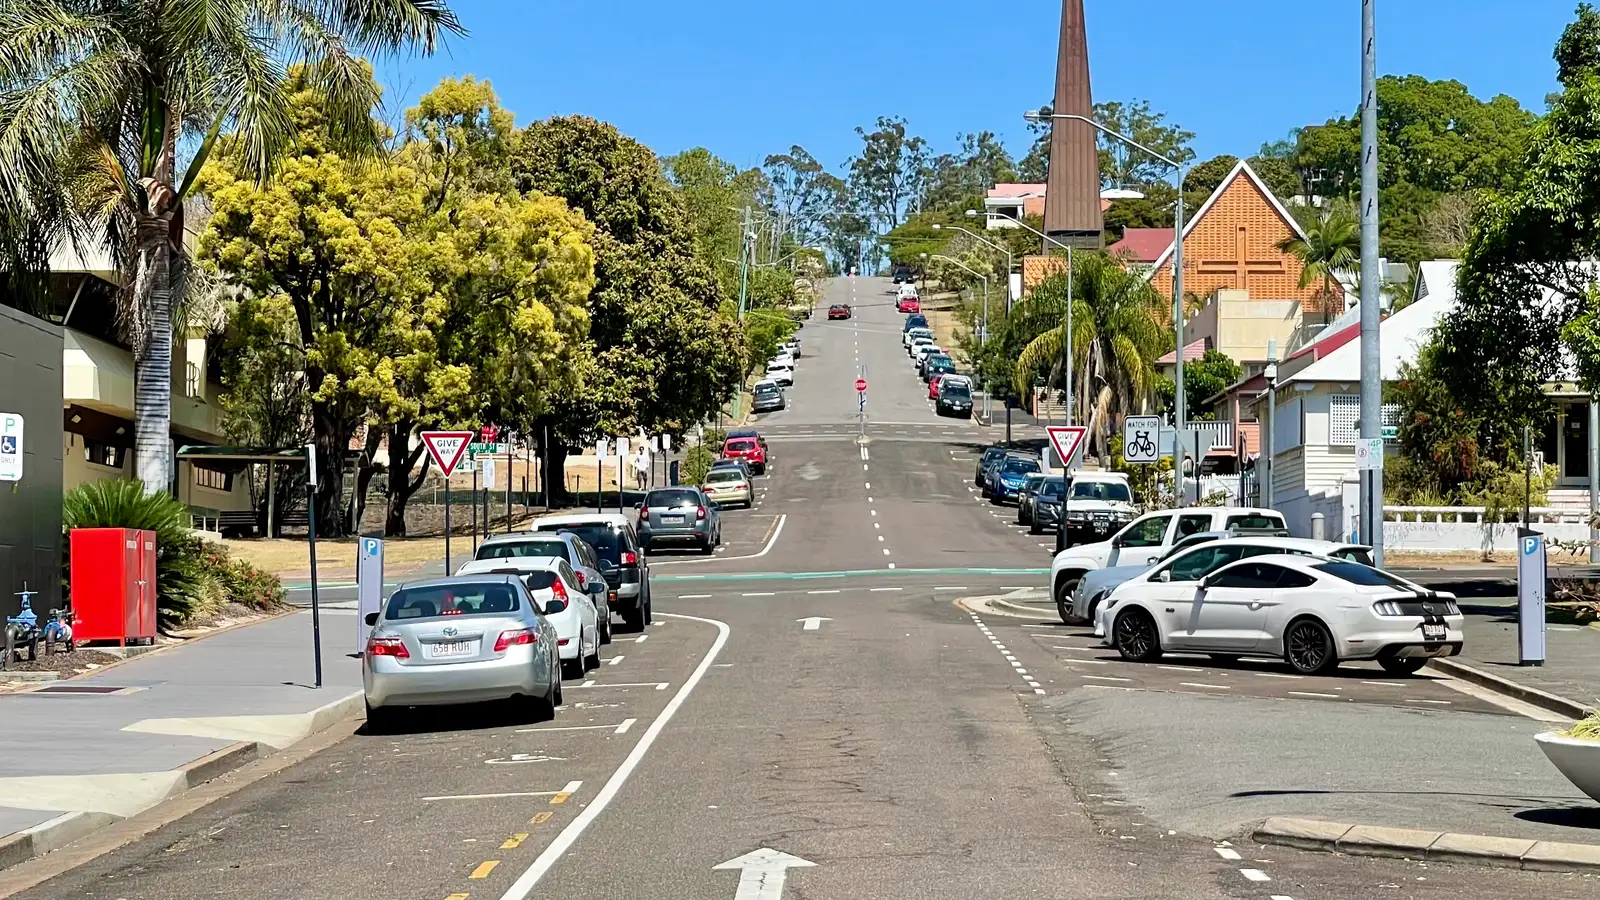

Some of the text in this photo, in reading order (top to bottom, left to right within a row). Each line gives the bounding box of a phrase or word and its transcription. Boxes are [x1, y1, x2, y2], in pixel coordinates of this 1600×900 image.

[5, 417, 15, 433] P
[1127, 421, 1145, 429] WATCH
[1057, 432, 1074, 440] GIVE
[437, 439, 459, 448] GIVE
[1370, 440, 1381, 448] 4P
[368, 541, 376, 553] P
[1526, 538, 1535, 553] P
[433, 641, 470, 653] 658 RUH
